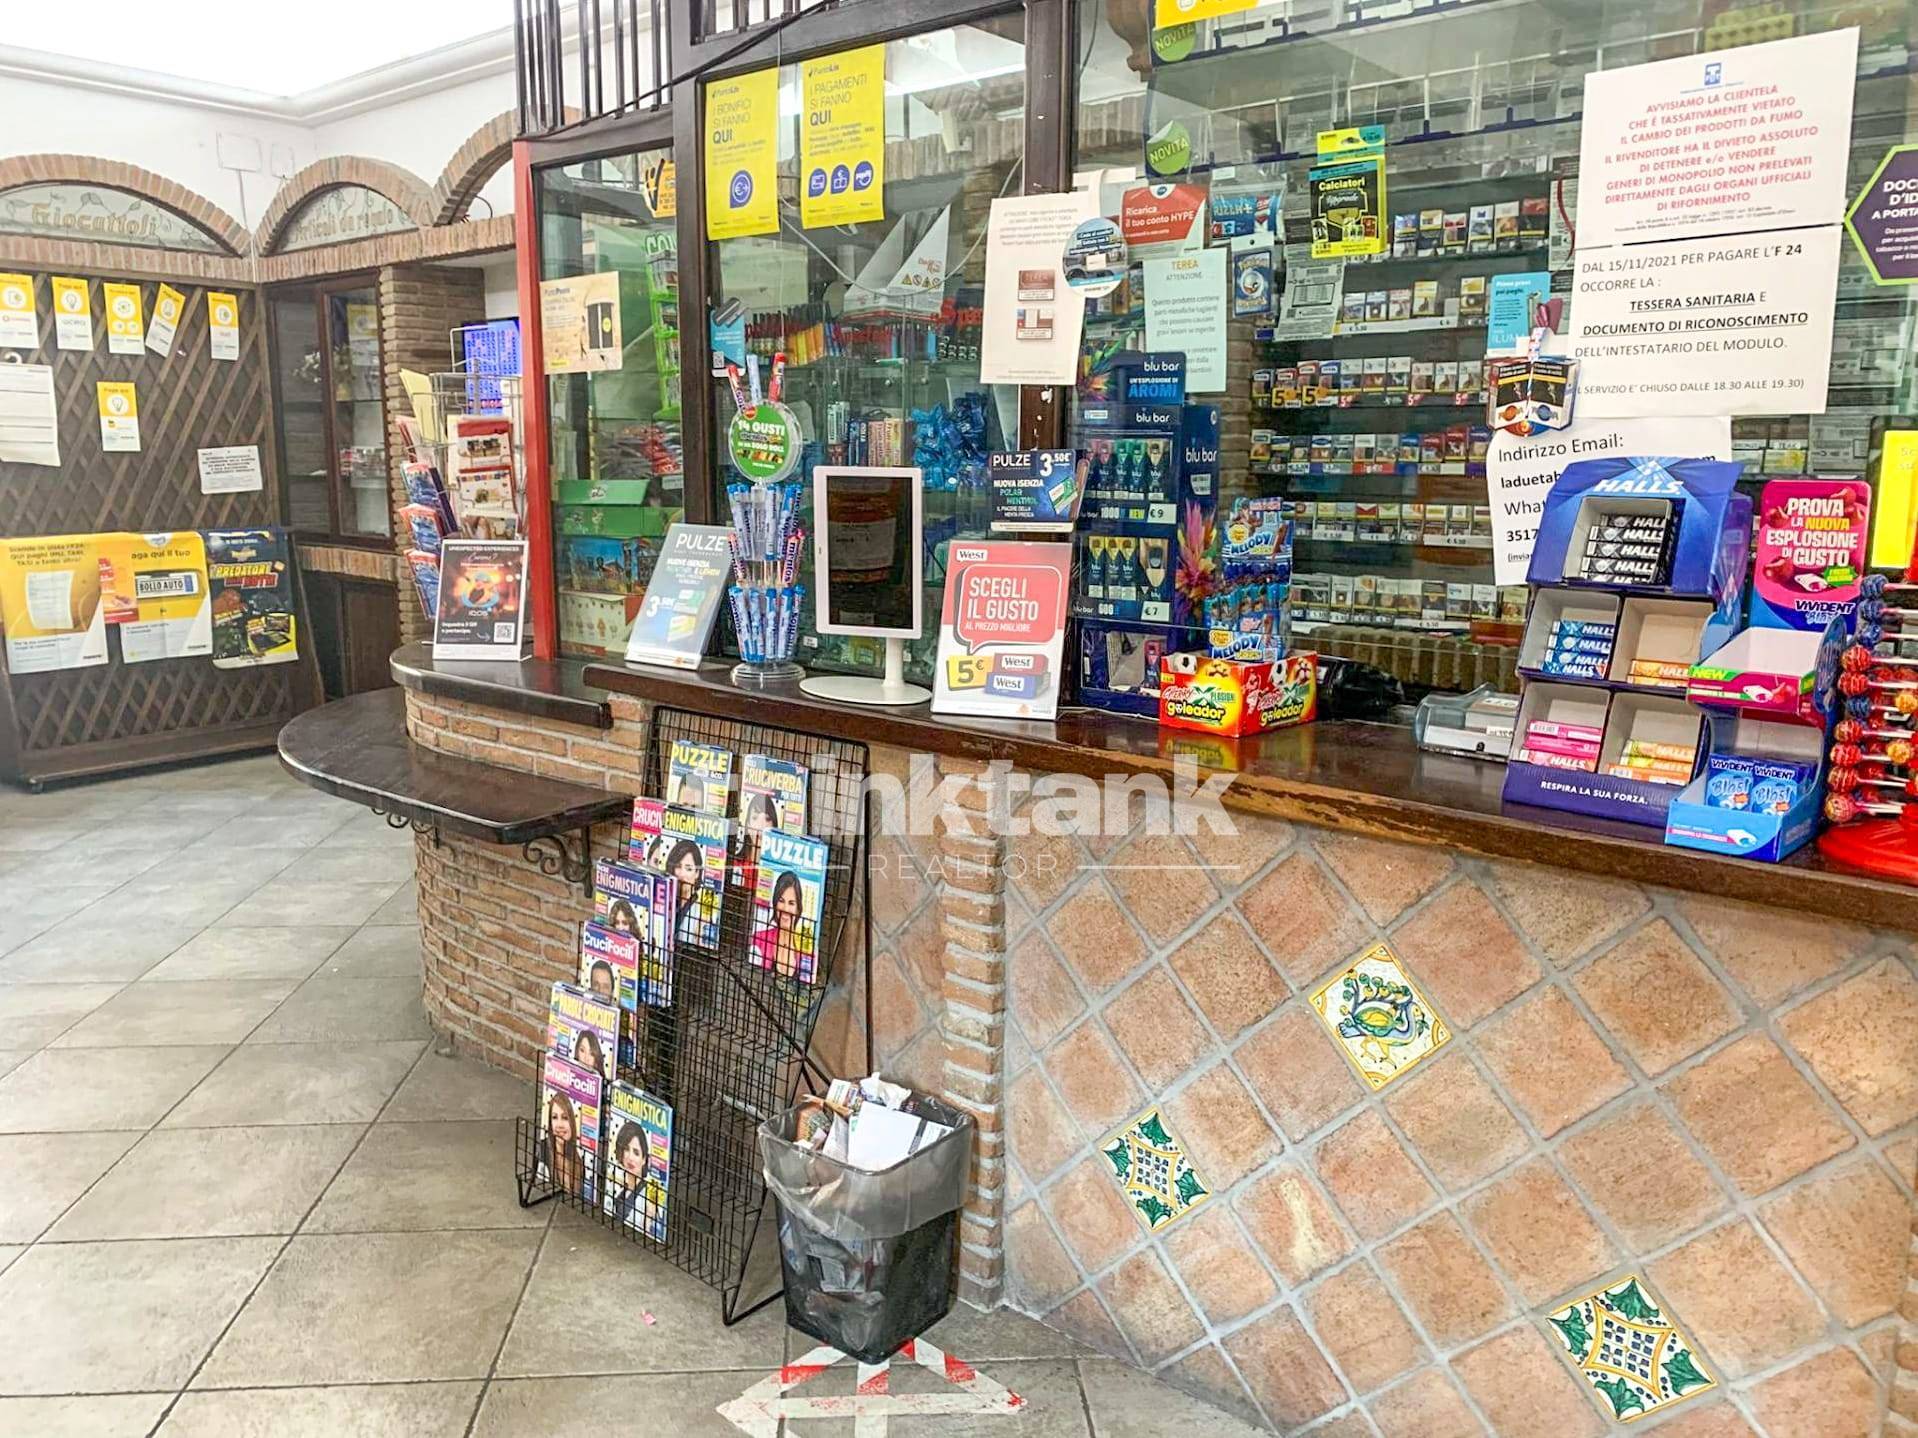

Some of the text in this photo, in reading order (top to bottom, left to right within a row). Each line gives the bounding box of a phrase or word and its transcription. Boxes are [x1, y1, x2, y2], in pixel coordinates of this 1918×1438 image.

[815, 76, 868, 94] PAGAMENTI
[810, 93, 852, 111] SI FANNO
[1646, 97, 1704, 113] AVVISIAMO
[1708, 94, 1720, 104] LA
[1724, 85, 1778, 102] CLIENTELA
[810, 110, 831, 126] QUI
[1629, 119, 1648, 130] CHE
[1661, 105, 1747, 125] TASSATIVAMENTE
[1753, 96, 1796, 110] VIETATO
[1621, 110, 1803, 145] IL CAMBIO DEI PRODOTTI DA FUMO
[713, 129, 733, 145] QUI
[1605, 126, 1819, 164] IL RIVENDITORE HA IL DIVIETO ASSOLUTO
[1640, 146, 1777, 172] DI DETENERE e/o VENDERE
[1607, 156, 1812, 190] GENERI DI MONOPOLIO NON PRELEVATI
[1319, 176, 1365, 192] Calciatori
[1605, 171, 1812, 204] DIRETTAMENTE DAGLI ORGANI UFFICIALI
[1126, 205, 1157, 216] Ricarica
[1657, 192, 1750, 211] DI RIFORNIMENTO
[31, 203, 159, 237] Giocattoli
[1132, 218, 1145, 227] tuo
[1146, 215, 1169, 226] conto
[1171, 210, 1195, 222] HYPE
[1171, 259, 1199, 269] TEREA
[1582, 262, 1604, 273] DAL
[1609, 255, 1676, 272] 15/11/2021
[1681, 254, 1704, 265] PER
[1708, 248, 1759, 262] PAGARE
[1786, 244, 1802, 255] 24
[1166, 273, 1202, 281] ATTENZIONE
[1580, 277, 1654, 292] OCCORRE LA
[1630, 292, 1767, 311] TESSERA SANITARIA E
[1583, 312, 1808, 336] DOCUMENTO DI RICONOSCIMENTO
[1575, 337, 1788, 357] DELL'INTESTATARIO DEL MODULO.
[1144, 361, 1180, 373] blu bar
[1128, 384, 1177, 398] AROMI
[1584, 384, 1626, 394] SERVIZIO
[1641, 383, 1678, 392] CHIUSO
[1680, 381, 1711, 391] DALLE
[1744, 380, 1767, 390] ALLE
[1136, 412, 1170, 423] blu bar
[752, 422, 785, 435] GUSTI
[1185, 447, 1217, 463] blu bar
[1499, 433, 1623, 462] Indirizzo Email:
[993, 454, 1031, 466] PULZE
[1157, 509, 1164, 519] 9
[1787, 498, 1844, 516] PROVA
[1791, 517, 1850, 531] LA NUOVA
[676, 534, 728, 551] PULZE
[1231, 532, 1272, 553] MELODY
[1766, 530, 1859, 549] ESPLOSIONE
[131, 551, 149, 560] aga
[150, 551, 164, 561] qui
[175, 549, 191, 557] tuo
[785, 542, 796, 582] mentos
[959, 550, 986, 560] West
[1782, 549, 1849, 567] DI GUSTO
[140, 580, 184, 591] BOLLO AUTO
[969, 577, 1027, 598] SCEGLI
[967, 599, 1039, 621] IL GUSTO
[965, 622, 1031, 633] AL PREZZO MIGLIORE
[1212, 636, 1261, 659] MELODY
[1004, 657, 1032, 667] West
[1562, 665, 1594, 677] HALLS
[995, 677, 1022, 689] West
[1693, 669, 1726, 680] NEW
[1167, 701, 1226, 720] goleador
[1260, 702, 1304, 727] goleador
[671, 745, 728, 773] PUZZLE
[1550, 756, 1586, 769] HALLS
[743, 768, 802, 793] CRUCIVERBA
[1541, 781, 1648, 805] RESPIRA LA SUA FORZA.
[665, 808, 724, 841] ENIGMISTICA
[762, 837, 823, 869] PUZZLE
[595, 870, 650, 900] ENIGMISTICA
[583, 931, 635, 962] CruciFacili
[545, 1065, 596, 1097] CruciFacili
[612, 1087, 668, 1131] ENIGMISTICA
